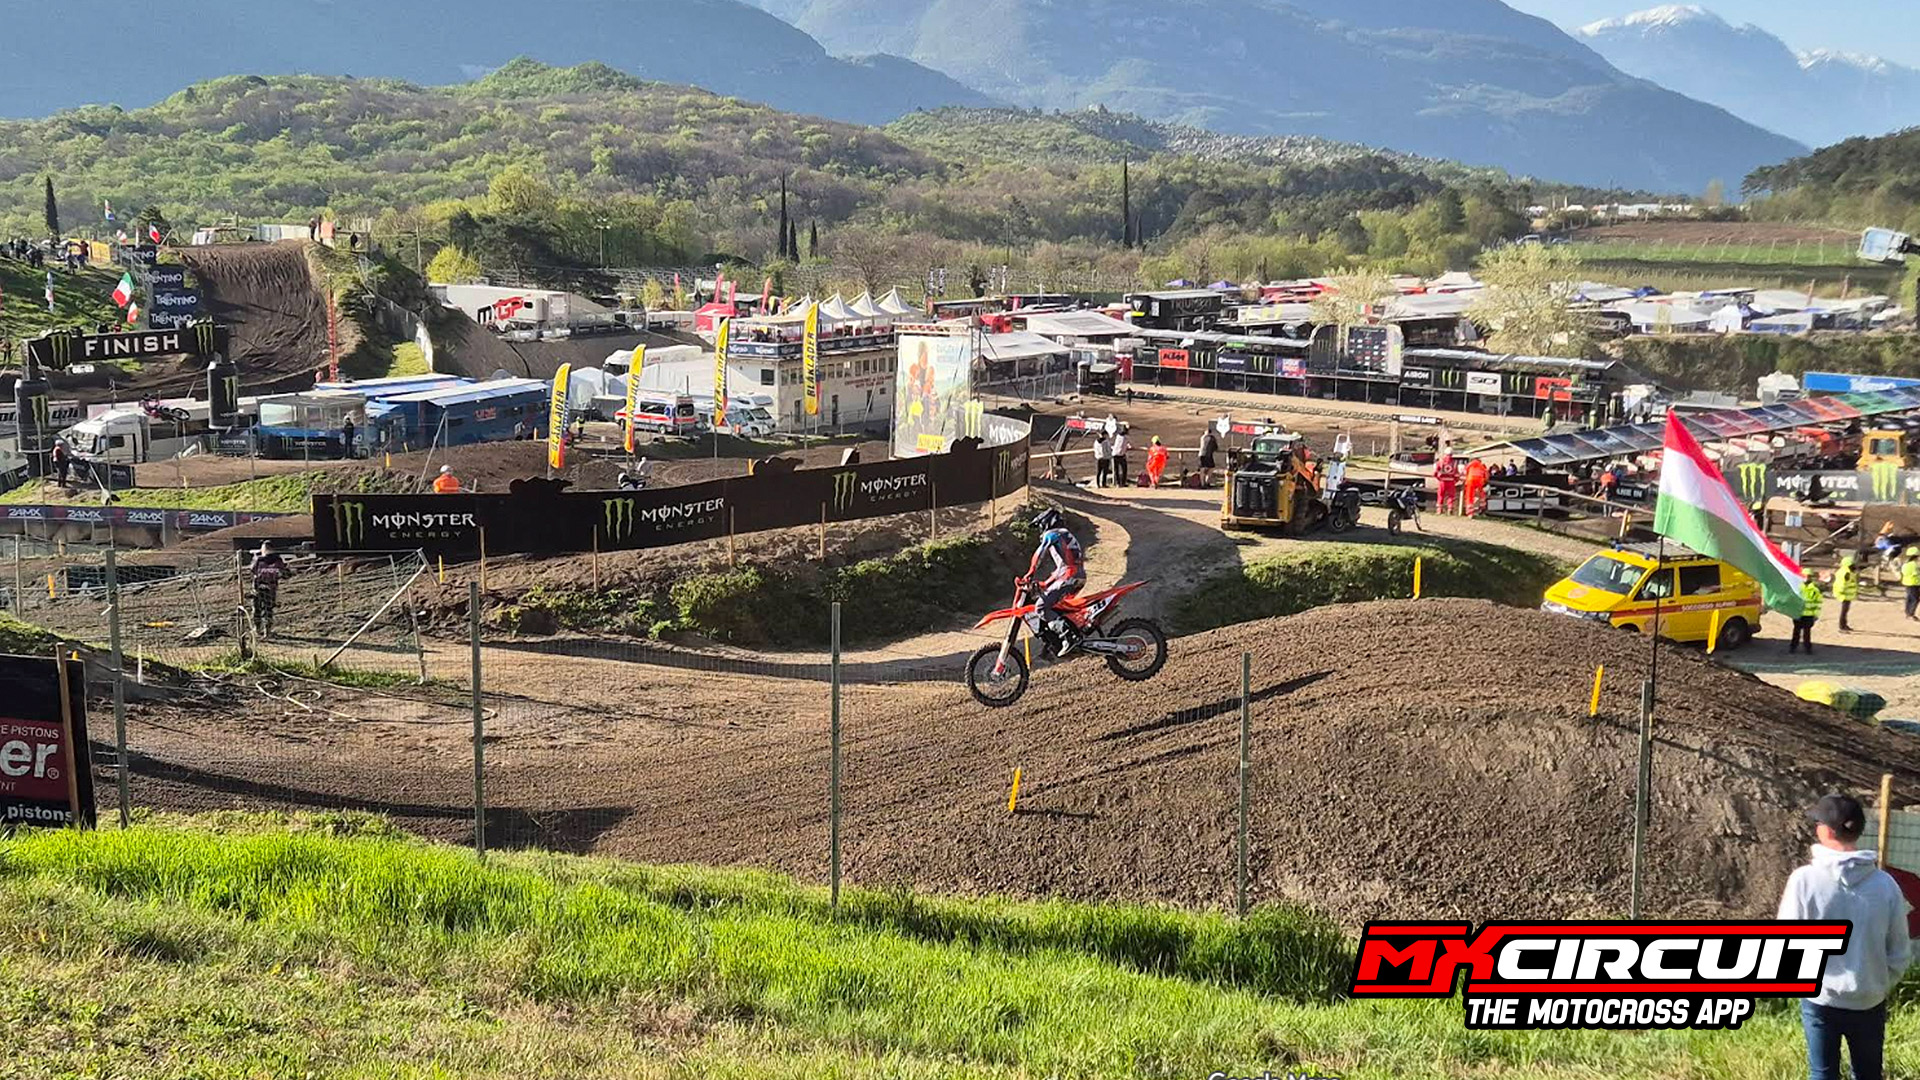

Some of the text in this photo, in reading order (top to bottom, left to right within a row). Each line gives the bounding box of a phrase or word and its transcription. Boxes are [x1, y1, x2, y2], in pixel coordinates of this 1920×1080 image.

[154, 293, 197, 306] TRENTINO
[84, 333, 180, 357] FINISH
[861, 472, 927, 491] MONSTER
[870, 489, 920, 502] ENERGY
[641, 497, 725, 521] MONSTER
[372, 511, 477, 529] MONSTER
[656, 515, 714, 532] ENERGY
[389, 530, 462, 539] ENERGY
[11, 725, 59, 739] PISTONS
[7, 804, 73, 821] pistons
